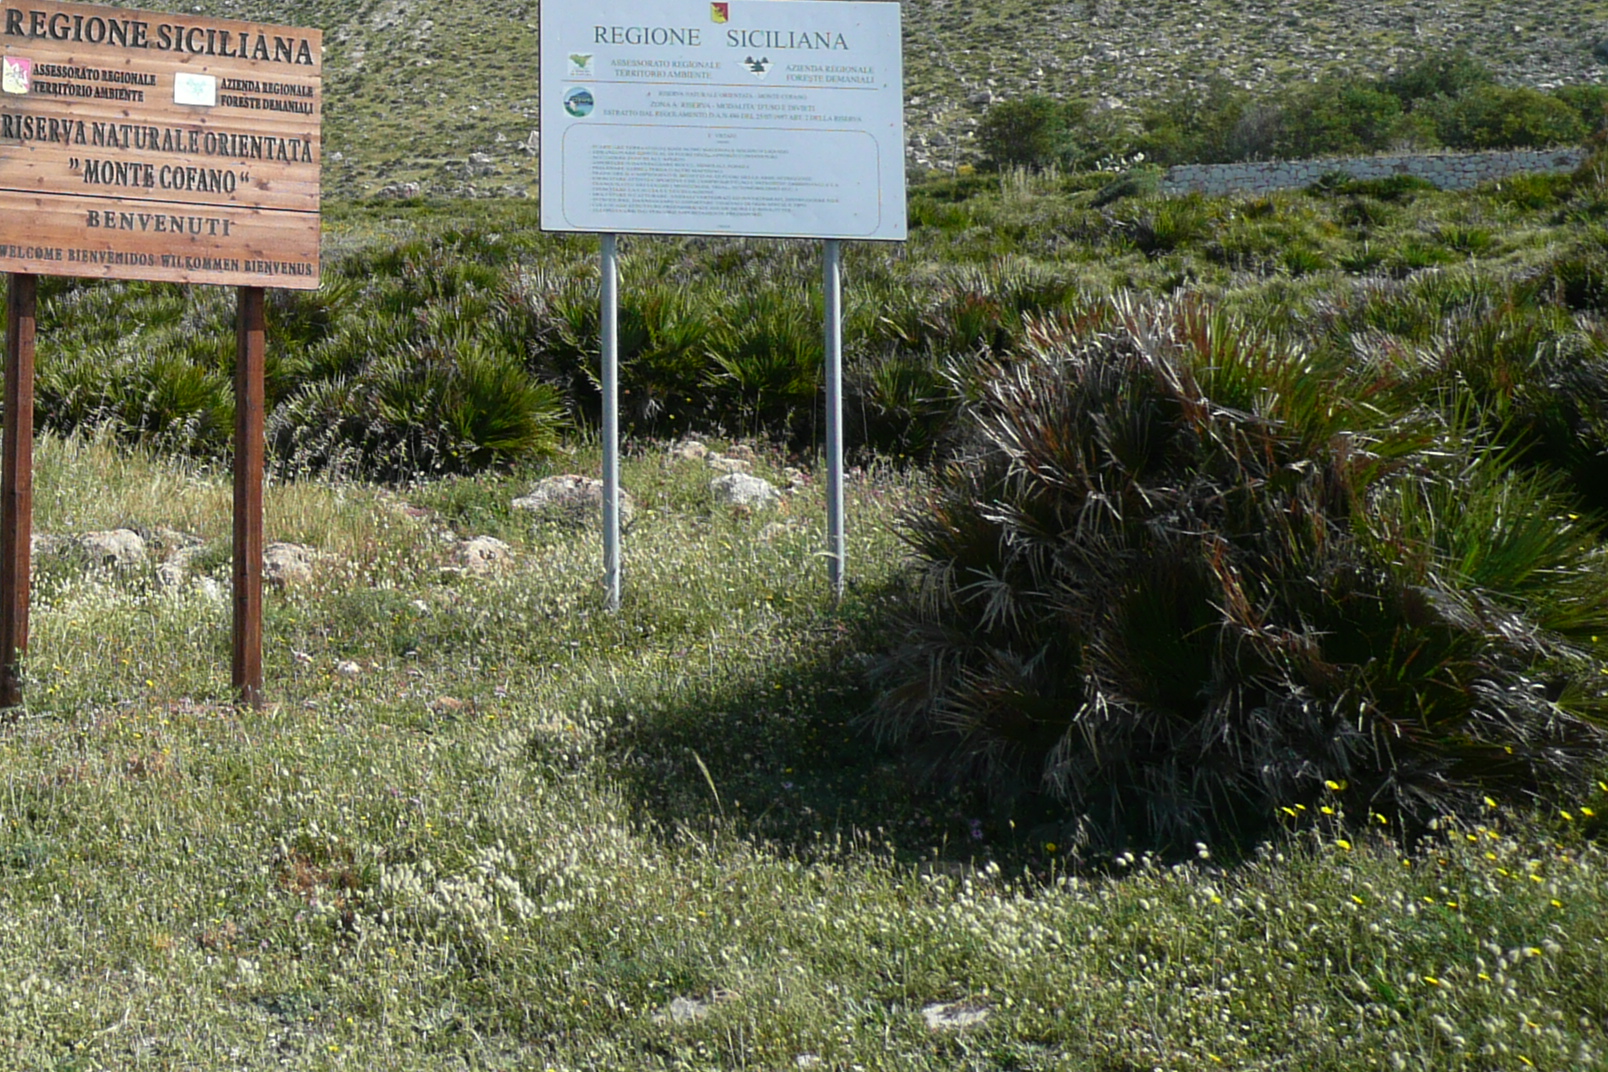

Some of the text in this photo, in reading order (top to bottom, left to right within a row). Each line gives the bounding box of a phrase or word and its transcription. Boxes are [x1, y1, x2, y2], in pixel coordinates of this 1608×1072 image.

[5, 8, 314, 66] REGIONE SICILIANA
[594, 26, 849, 50] REGIONE SICILIANA
[33, 63, 156, 86] ASSESSORATO REGIONALE
[610, 59, 721, 69] ASSESSORATO REGIONALE
[615, 69, 712, 79] TERRITORIO AMBIENTE
[785, 64, 874, 74] AZIENDA REGIONALE
[221, 78, 313, 98] AZIENDA REGIONALE
[786, 74, 875, 84] FORESTE DEMANIALI
[33, 80, 144, 102] TERRITORIO AMBIENTE
[221, 95, 313, 114] FORESTE DEMANIALI
[1, 114, 312, 163] RISERVA NATURALE ORIENTATA
[83, 159, 154, 188] MONTE
[159, 165, 236, 194] COFANO
[87, 210, 230, 236] BENVENUTI
[161, 254, 239, 272] WILKOMMEN
[244, 259, 312, 276] BIENVENUS
